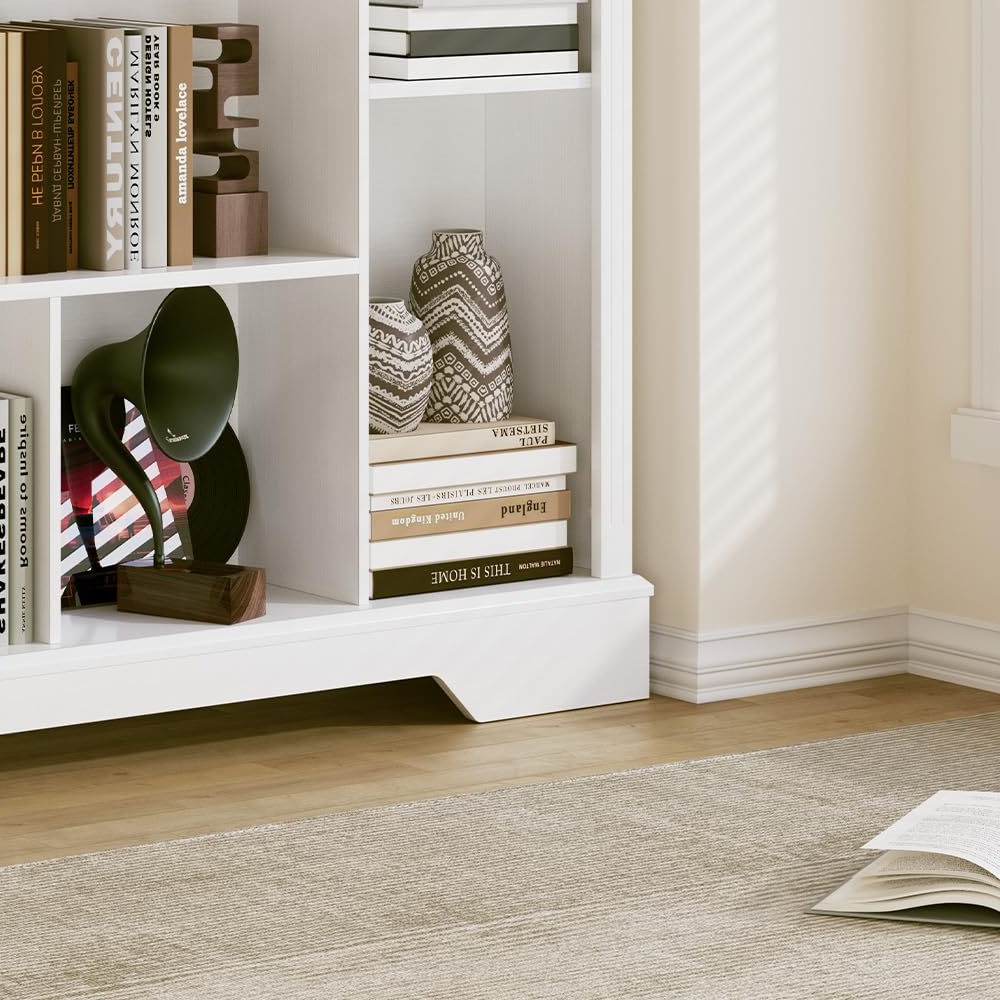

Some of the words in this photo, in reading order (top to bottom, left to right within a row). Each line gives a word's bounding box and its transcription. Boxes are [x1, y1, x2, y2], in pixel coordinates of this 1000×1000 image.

[175, 82, 188, 142] lovelace
[175, 146, 188, 205] amanda
[492, 424, 549, 438] SIETSEMA
[519, 436, 548, 447] PAUL
[477, 486, 492, 495] LES
[501, 500, 546, 518] England
[392, 515, 432, 527] Kingdom
[434, 511, 465, 524] United
[431, 568, 467, 584] HOME
[471, 566, 481, 579] IS
[485, 562, 511, 577] THIS
